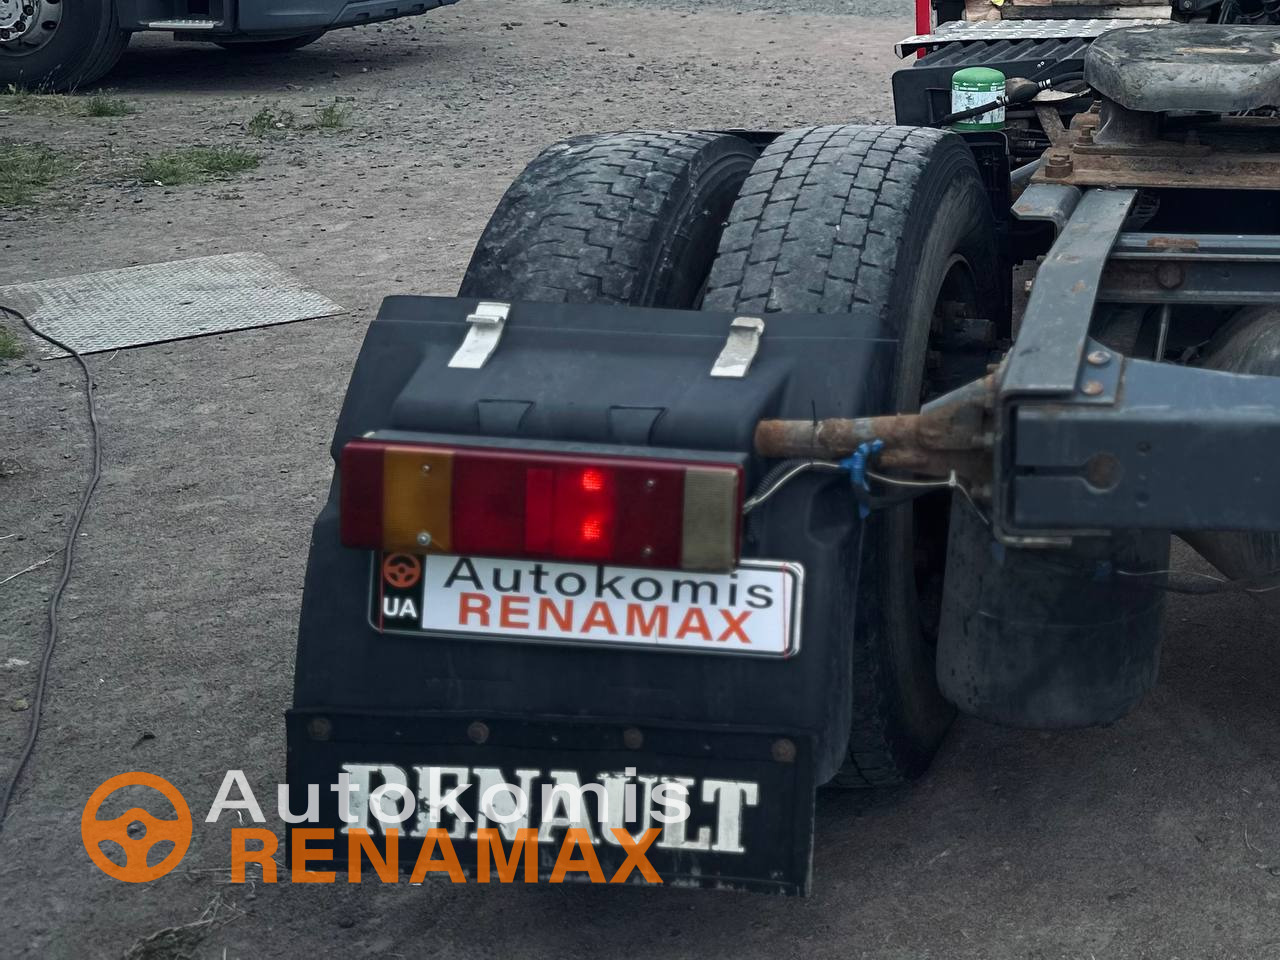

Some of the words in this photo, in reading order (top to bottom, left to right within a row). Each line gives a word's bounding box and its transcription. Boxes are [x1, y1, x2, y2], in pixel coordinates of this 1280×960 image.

[383, 597, 418, 618] UA
[443, 557, 774, 610] Autokomis
[458, 591, 753, 644] RENAMAX
[341, 763, 759, 853] RENAULT
